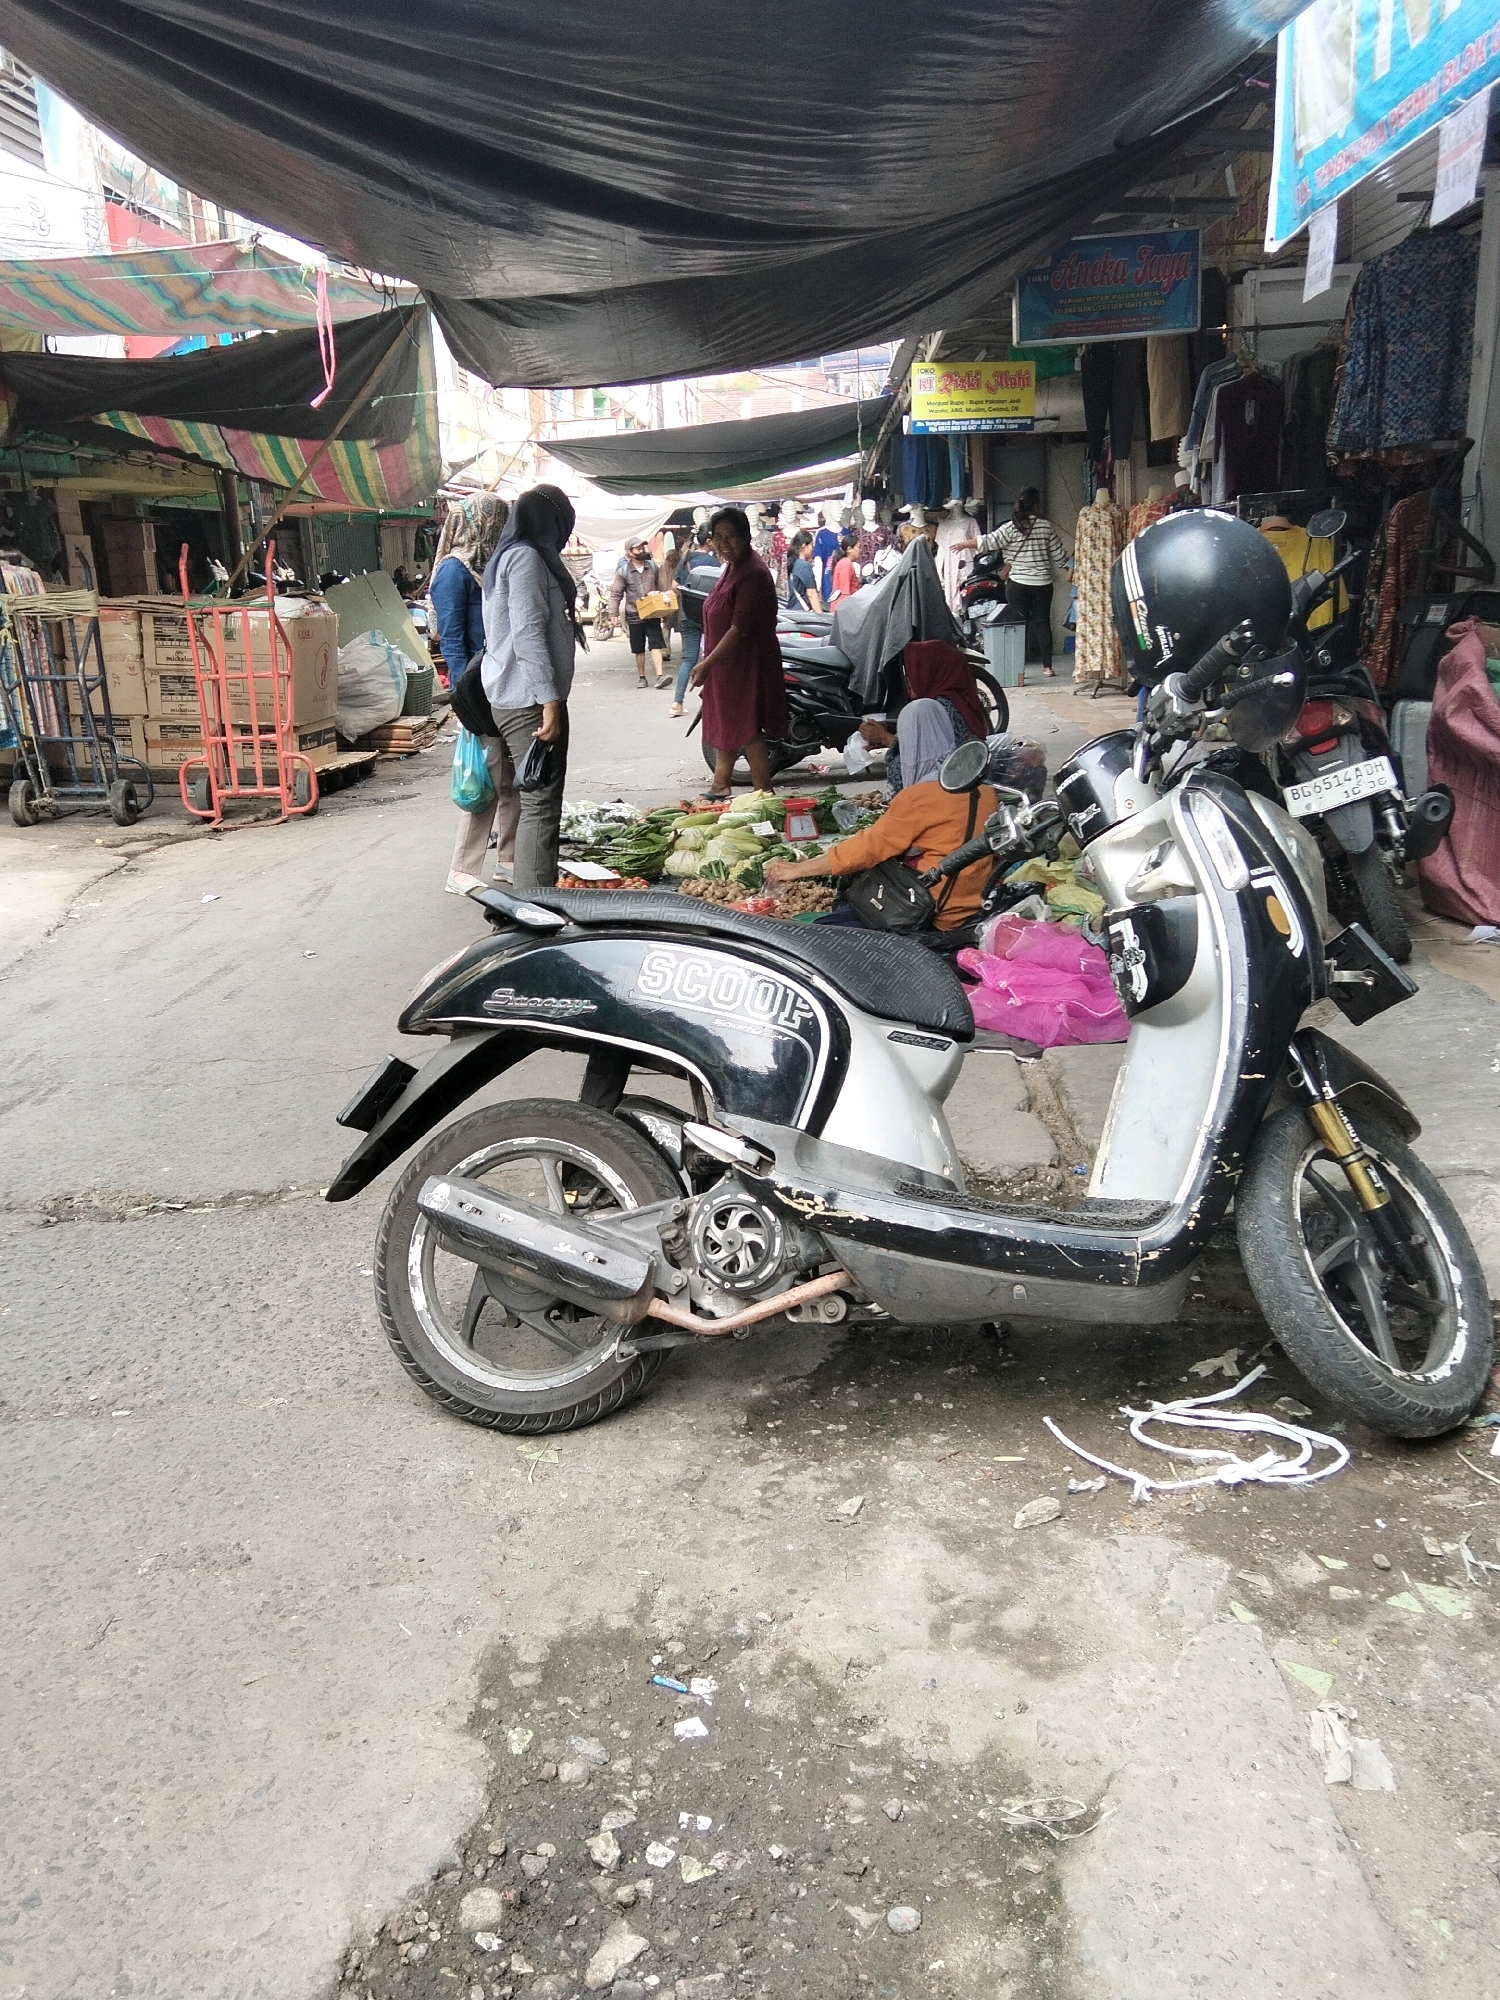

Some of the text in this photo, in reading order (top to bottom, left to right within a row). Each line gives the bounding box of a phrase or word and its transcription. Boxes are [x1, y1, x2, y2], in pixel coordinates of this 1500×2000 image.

[1442, 38, 1488, 94] BLOK
[1050, 244, 1192, 295] Aneka Jaya
[916, 367, 936, 375] TOKO
[938, 370, 982, 397] Rizki
[949, 399, 965, 407] Rupa
[969, 398, 984, 406] Rupa
[1055, 768, 1088, 795] HONDA
[487, 987, 596, 1017] Scoopy
